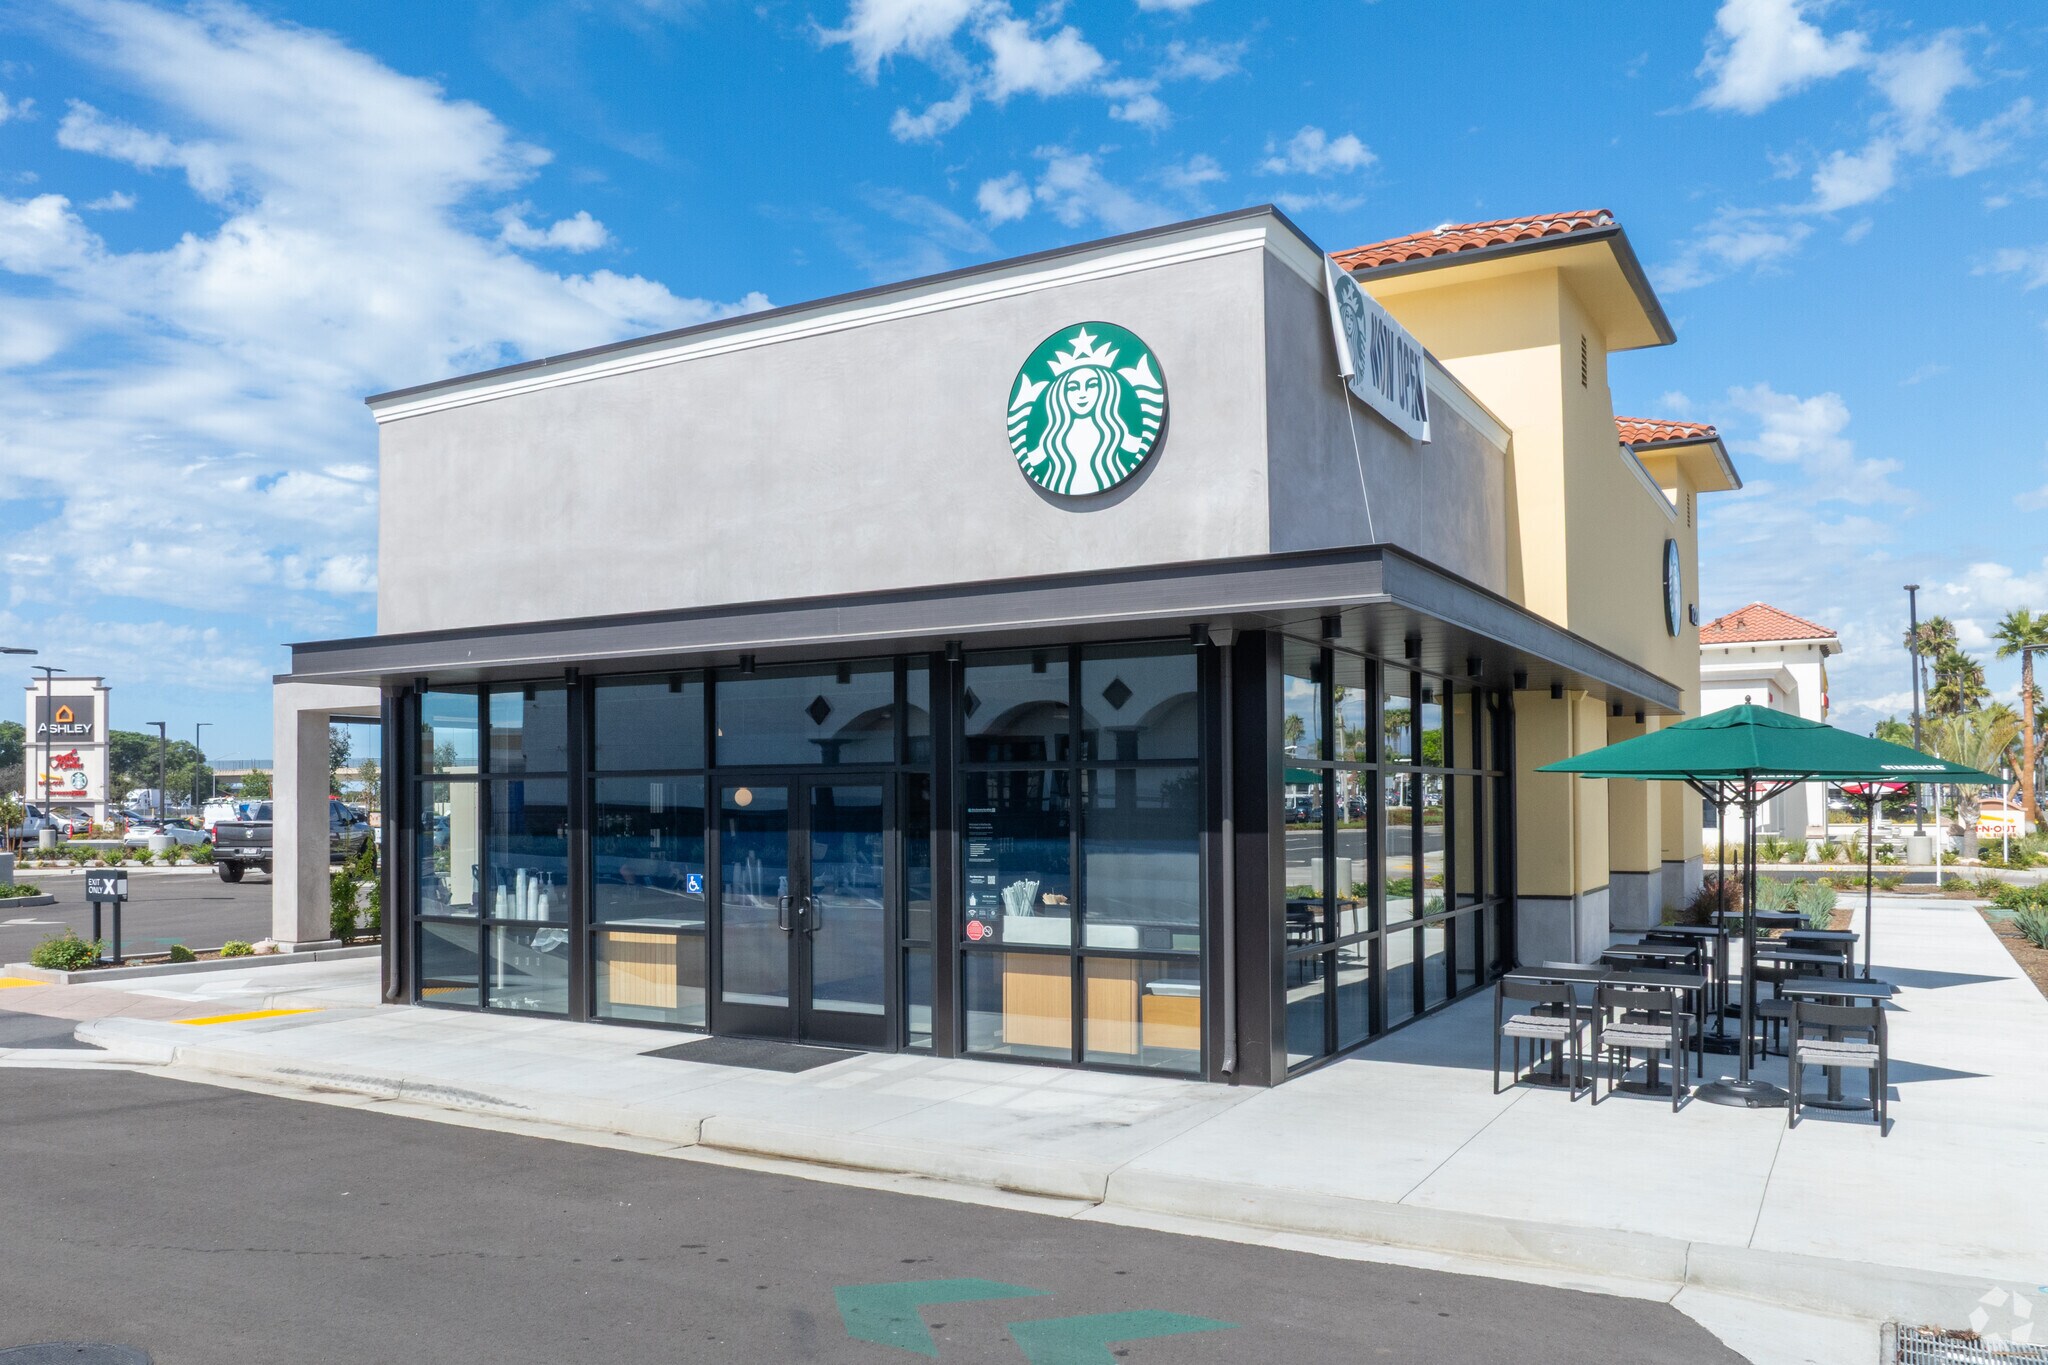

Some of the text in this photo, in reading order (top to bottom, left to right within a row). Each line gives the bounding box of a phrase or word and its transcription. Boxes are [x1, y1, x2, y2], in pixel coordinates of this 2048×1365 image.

[1370, 312, 1427, 422] NOW OPEN
[37, 722, 92, 734] ASHLEY
[88, 878, 101, 886] EXIT
[88, 886, 104, 894] ONLY
